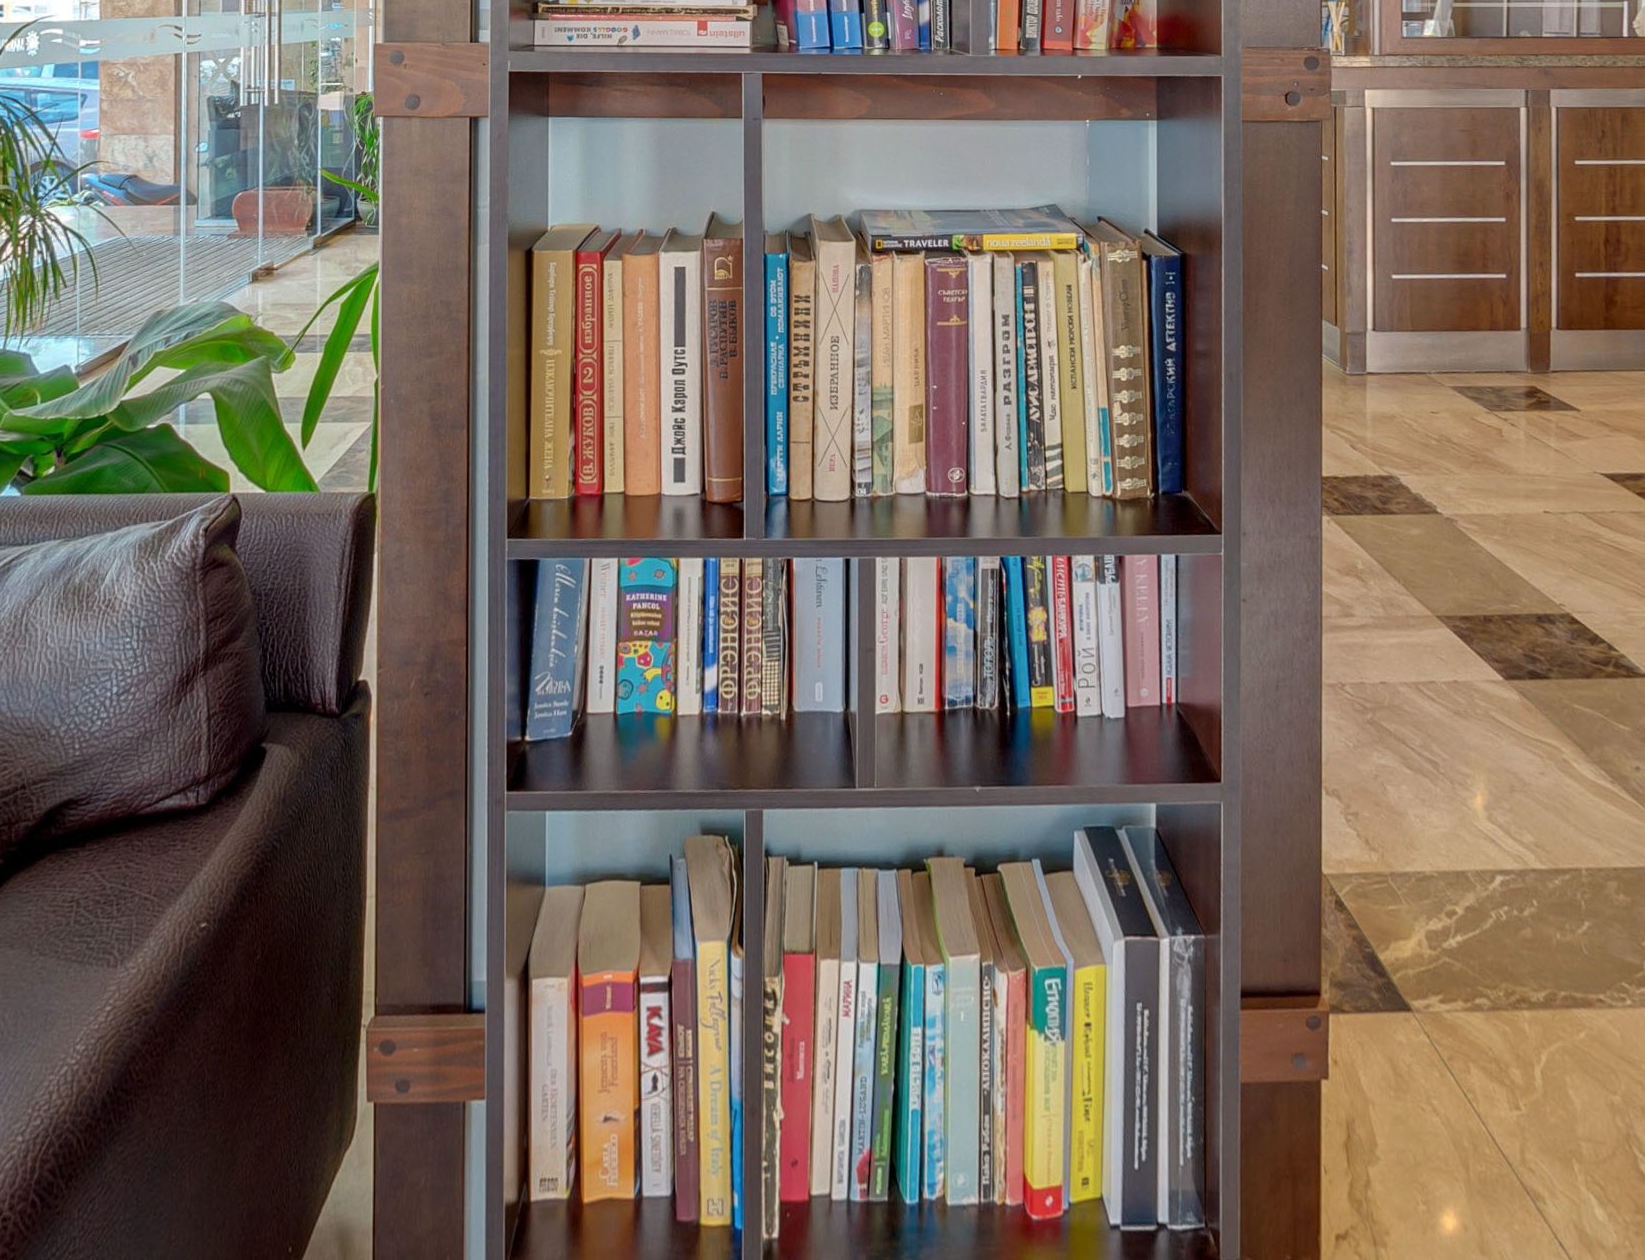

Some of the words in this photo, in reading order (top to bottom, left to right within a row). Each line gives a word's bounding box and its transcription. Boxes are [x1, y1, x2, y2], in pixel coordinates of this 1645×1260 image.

[710, 30, 745, 38] ullstein
[1026, 15, 1037, 39] ВИКТОР
[903, 239, 950, 248] TRAVELER
[986, 239, 1009, 247] noua
[831, 264, 840, 294] ПАНОВА
[580, 275, 596, 344] избранное
[770, 307, 778, 318] ОБ
[776, 267, 784, 333] ПОМАЛКИВАЮТ
[1065, 284, 1073, 314] НОВЕЛИ
[709, 299, 719, 354] ГУСАРОВ
[718, 299, 728, 366] РАСПУТИН
[728, 299, 738, 344] БЫКОВ
[1067, 315, 1075, 346] МОРСКИ
[1164, 291, 1176, 352] ДЕТЕКТИВ
[792, 295, 811, 403] СТРЪМНИНИ
[1001, 313, 1012, 406] РАЗГРОМ
[1023, 300, 1039, 384] АРМСТРОНГ
[582, 367, 593, 384] 2
[671, 348, 688, 376] Оутс
[770, 341, 778, 395] ПРЕКРАСНАЯ
[777, 343, 785, 389] СВИНАРКА
[829, 335, 840, 411] ИЗБРАННОЕ
[1068, 348, 1077, 390] ИСПАНСКИ
[671, 379, 688, 413] Кэрол
[979, 369, 988, 404] ГВАРДИЯ
[1027, 385, 1040, 423] ЛУИС
[581, 406, 595, 460] ЖУКОВ
[671, 417, 687, 456] Джойс
[776, 410, 784, 442] ЛАРНИ
[979, 404, 988, 433] БЯЛАТА
[544, 441, 555, 469] ЖЕНА
[582, 462, 593, 474] В.
[828, 453, 836, 472] ВЕРА
[626, 593, 667, 602] KATHERINE
[632, 602, 660, 610] PANCOL
[1136, 574, 1150, 625] KELLY
[720, 577, 738, 700] ФРЭНСИС
[744, 577, 762, 700] ФРЭНСИС
[981, 1114, 990, 1152] Рабан
[981, 1154, 990, 1185] Пако
